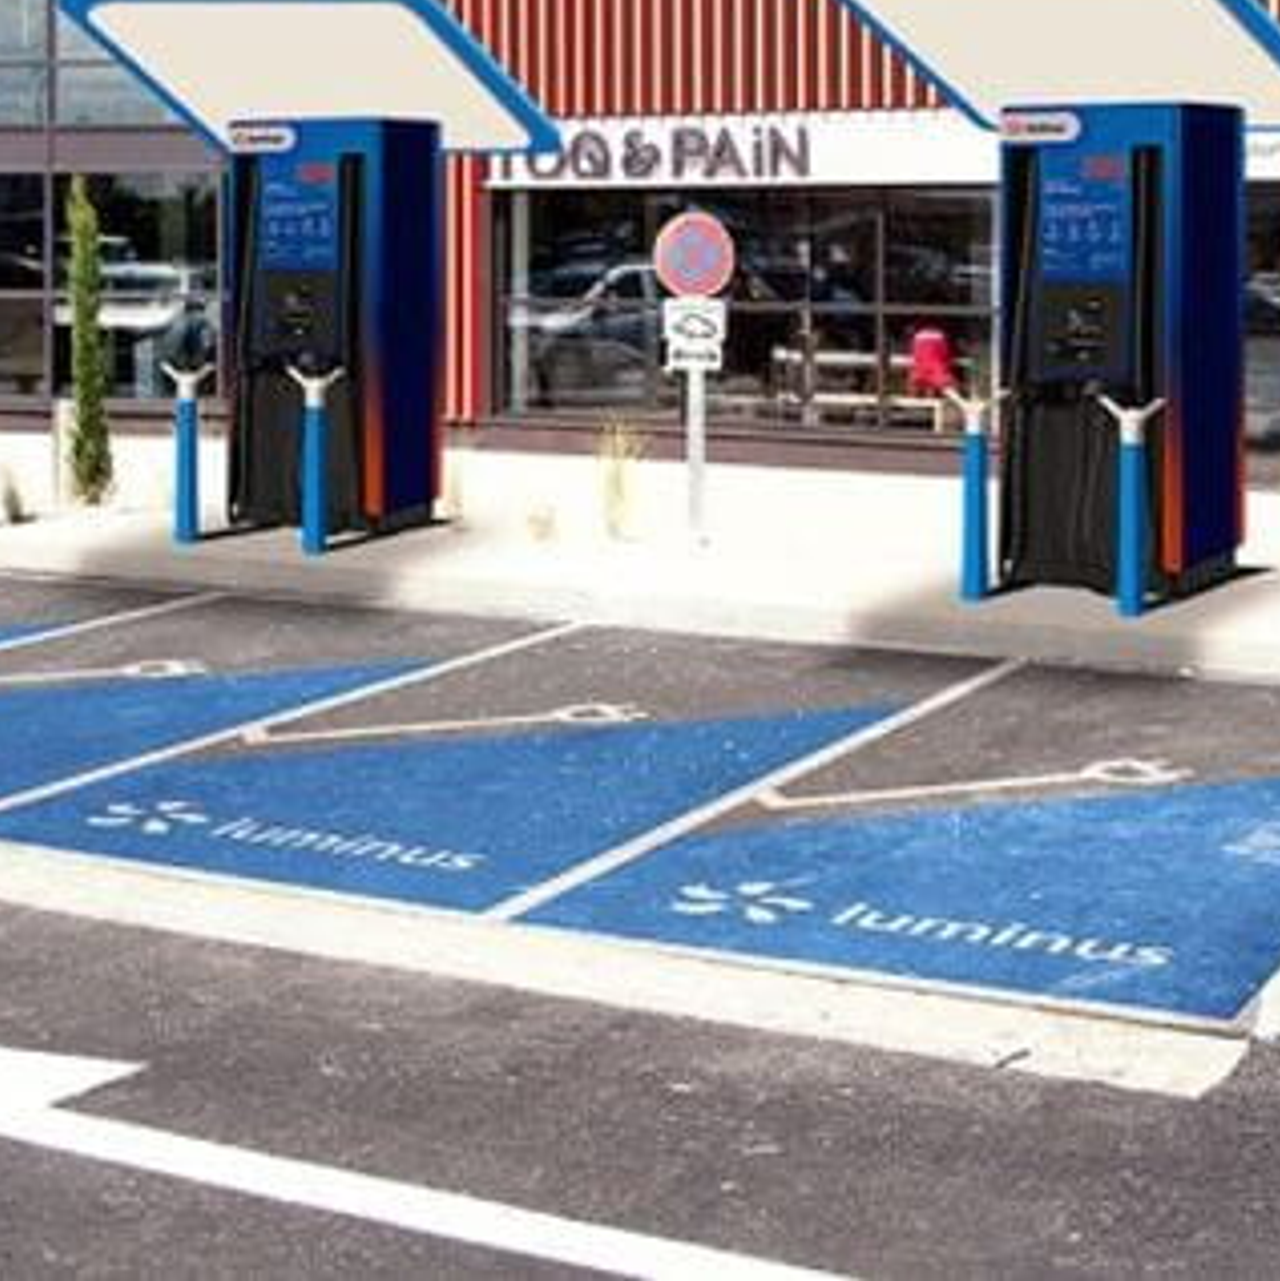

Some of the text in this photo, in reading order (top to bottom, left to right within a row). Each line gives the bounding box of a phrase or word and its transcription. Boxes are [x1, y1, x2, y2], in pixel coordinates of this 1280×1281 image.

[623, 131, 662, 178] &
[214, 819, 489, 871] luminus
[830, 902, 1175, 967] luminus
